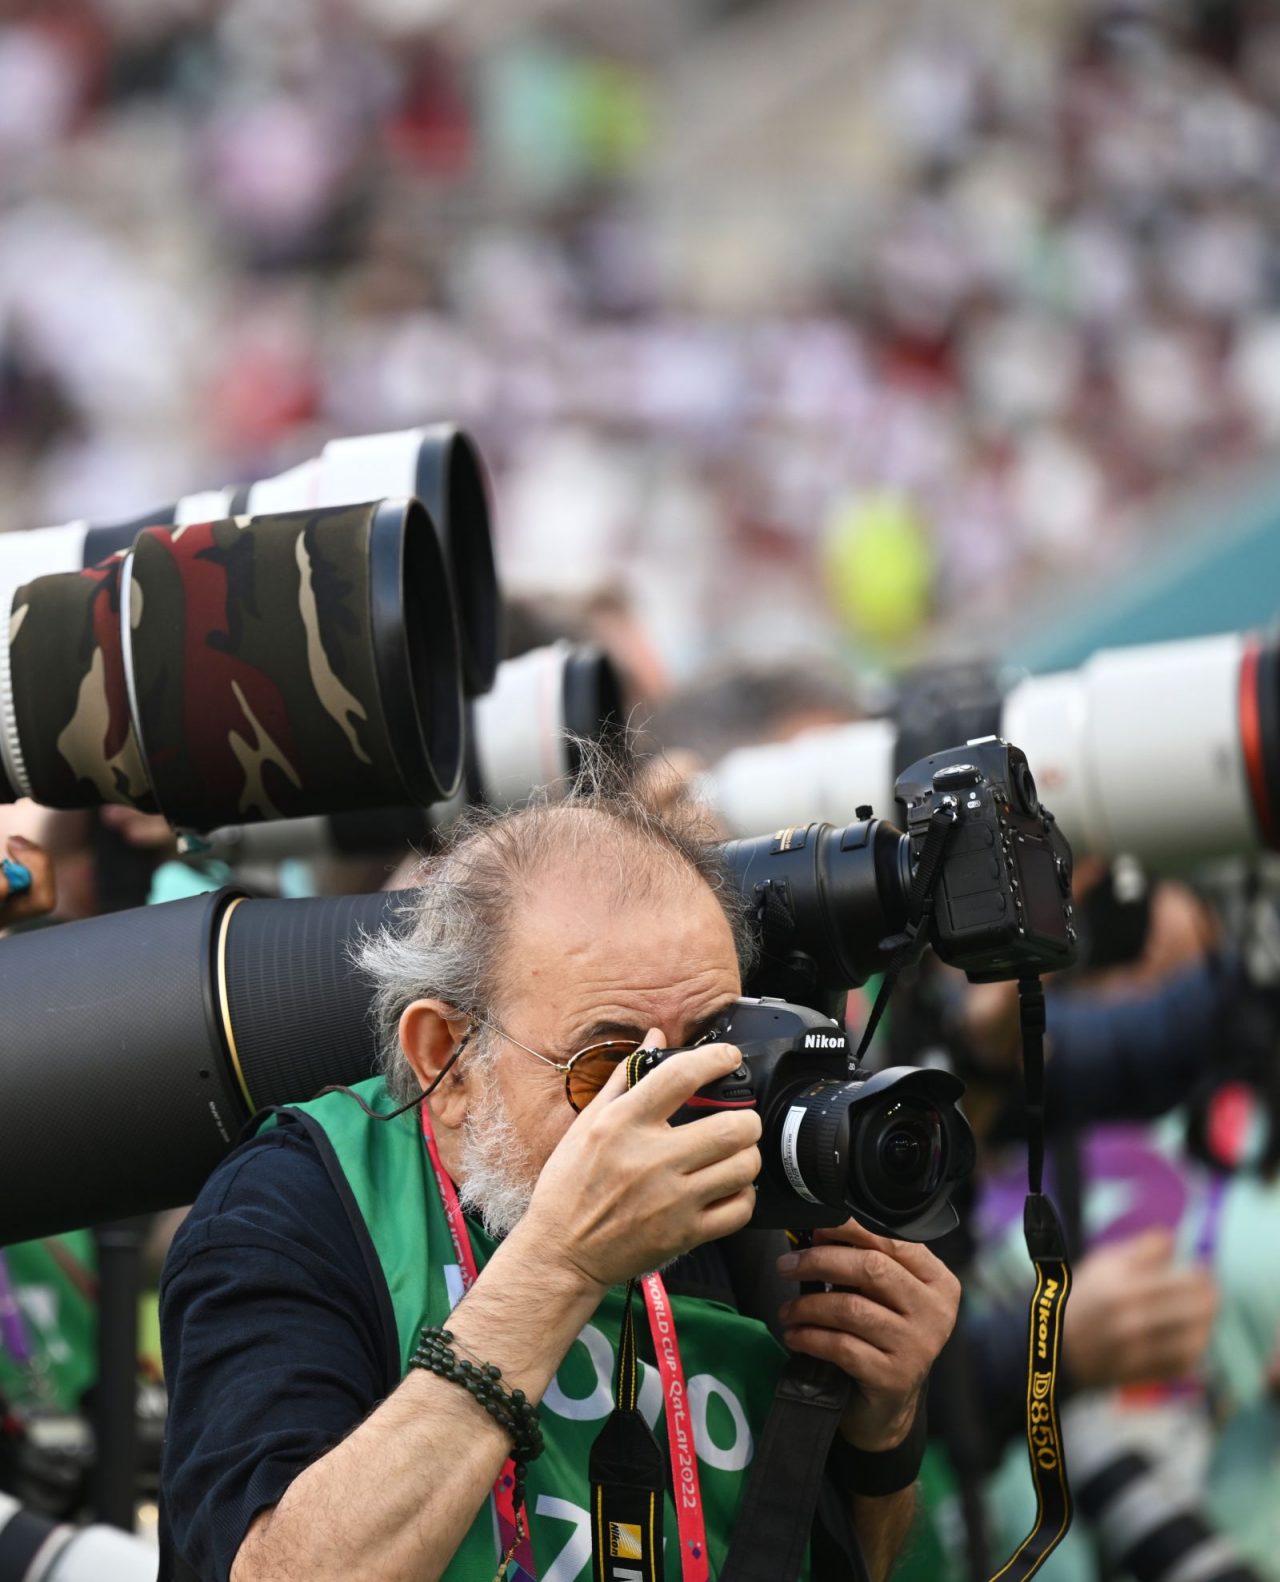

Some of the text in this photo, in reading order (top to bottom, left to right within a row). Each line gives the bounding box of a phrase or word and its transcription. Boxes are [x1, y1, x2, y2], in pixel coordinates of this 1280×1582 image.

[804, 1034, 845, 1048] Nikon
[662, 1336, 677, 1371] CUP
[1031, 1278, 1059, 1470] Nikon D850
[610, 1522, 620, 1556] Nikon
